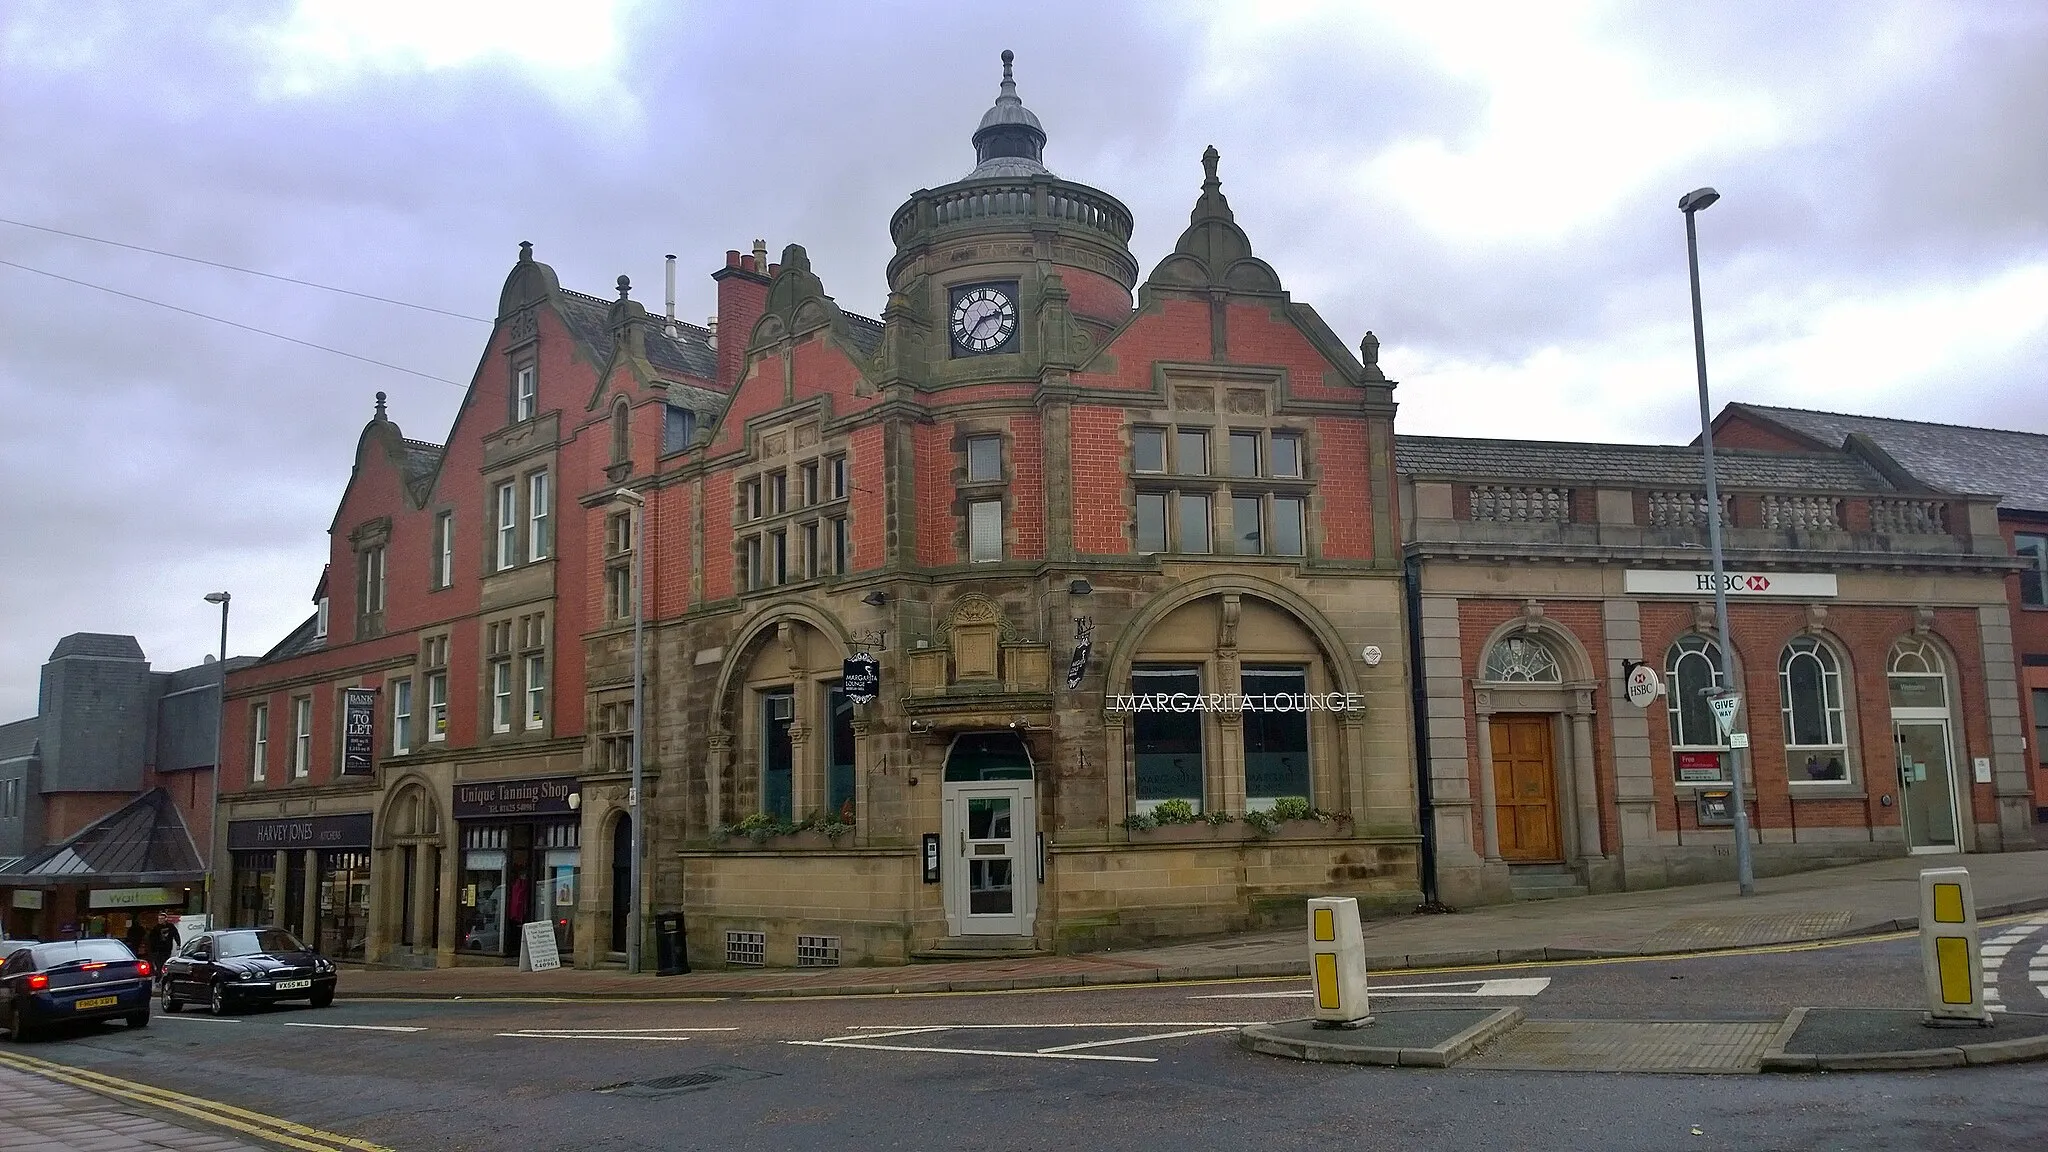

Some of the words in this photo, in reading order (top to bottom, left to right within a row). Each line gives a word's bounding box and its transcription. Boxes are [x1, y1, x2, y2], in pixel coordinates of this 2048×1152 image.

[1630, 683, 1653, 697] HSBC
[350, 694, 373, 702] BANK
[1115, 692, 1256, 713] MARGARITA
[1263, 692, 1358, 713] LOUNGE
[1714, 699, 1734, 709] GIVE
[352, 714, 370, 725] TO
[349, 724, 373, 735] LET
[461, 787, 495, 805] Unique
[497, 784, 539, 802] Tanning
[541, 782, 568, 800] Shop
[257, 825, 287, 841] HARVEY
[289, 823, 313, 841] JONES
